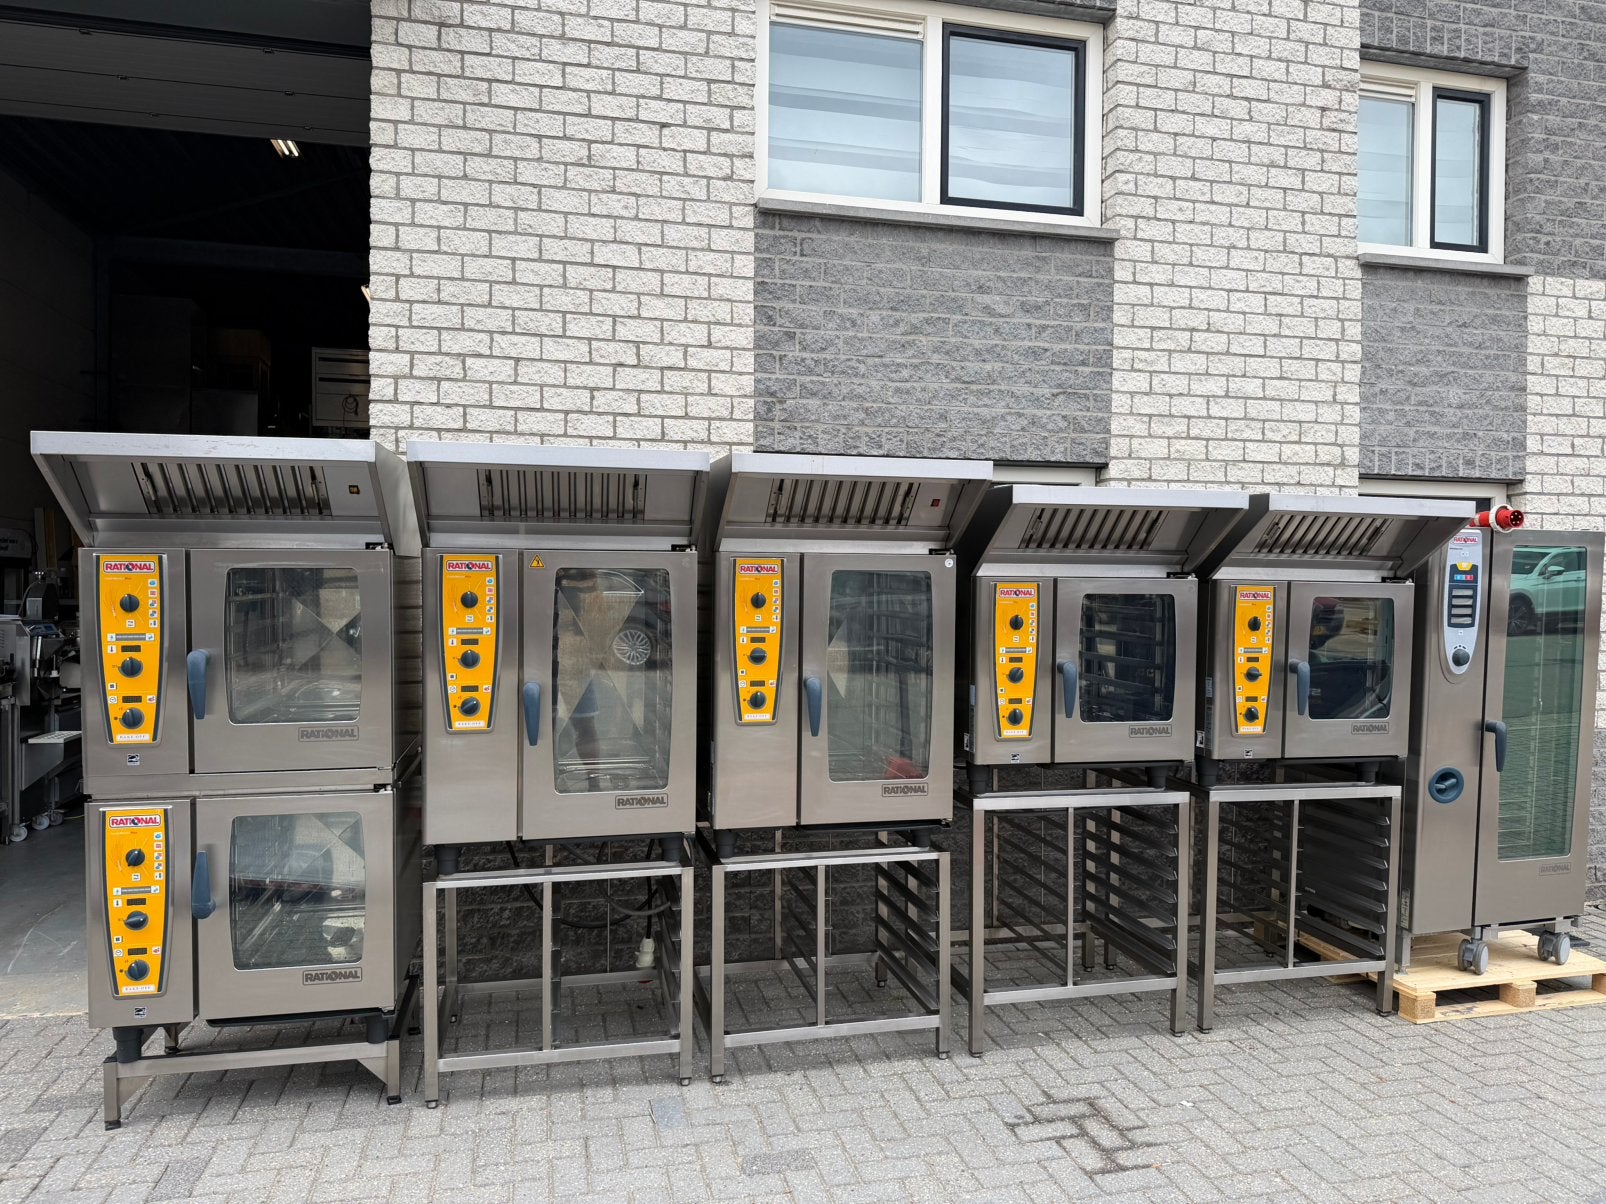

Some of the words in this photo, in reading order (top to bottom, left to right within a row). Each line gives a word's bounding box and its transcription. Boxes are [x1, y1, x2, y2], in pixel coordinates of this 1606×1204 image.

[105, 562, 153, 571] RATIONAL
[447, 561, 491, 571] RATIONAL
[740, 565, 777, 573] RATIONAL
[1000, 588, 1034, 597] RATIONAL
[1240, 591, 1270, 599] RATIONAL
[1131, 727, 1170, 736] RATIONAL
[1353, 724, 1387, 732] RATIONAL
[301, 729, 356, 739] RATIONAL
[884, 786, 926, 794] RATIONAL
[617, 796, 666, 806] RATIONAL
[111, 816, 159, 826] RATIONAL
[305, 970, 360, 982] RATIONAL
